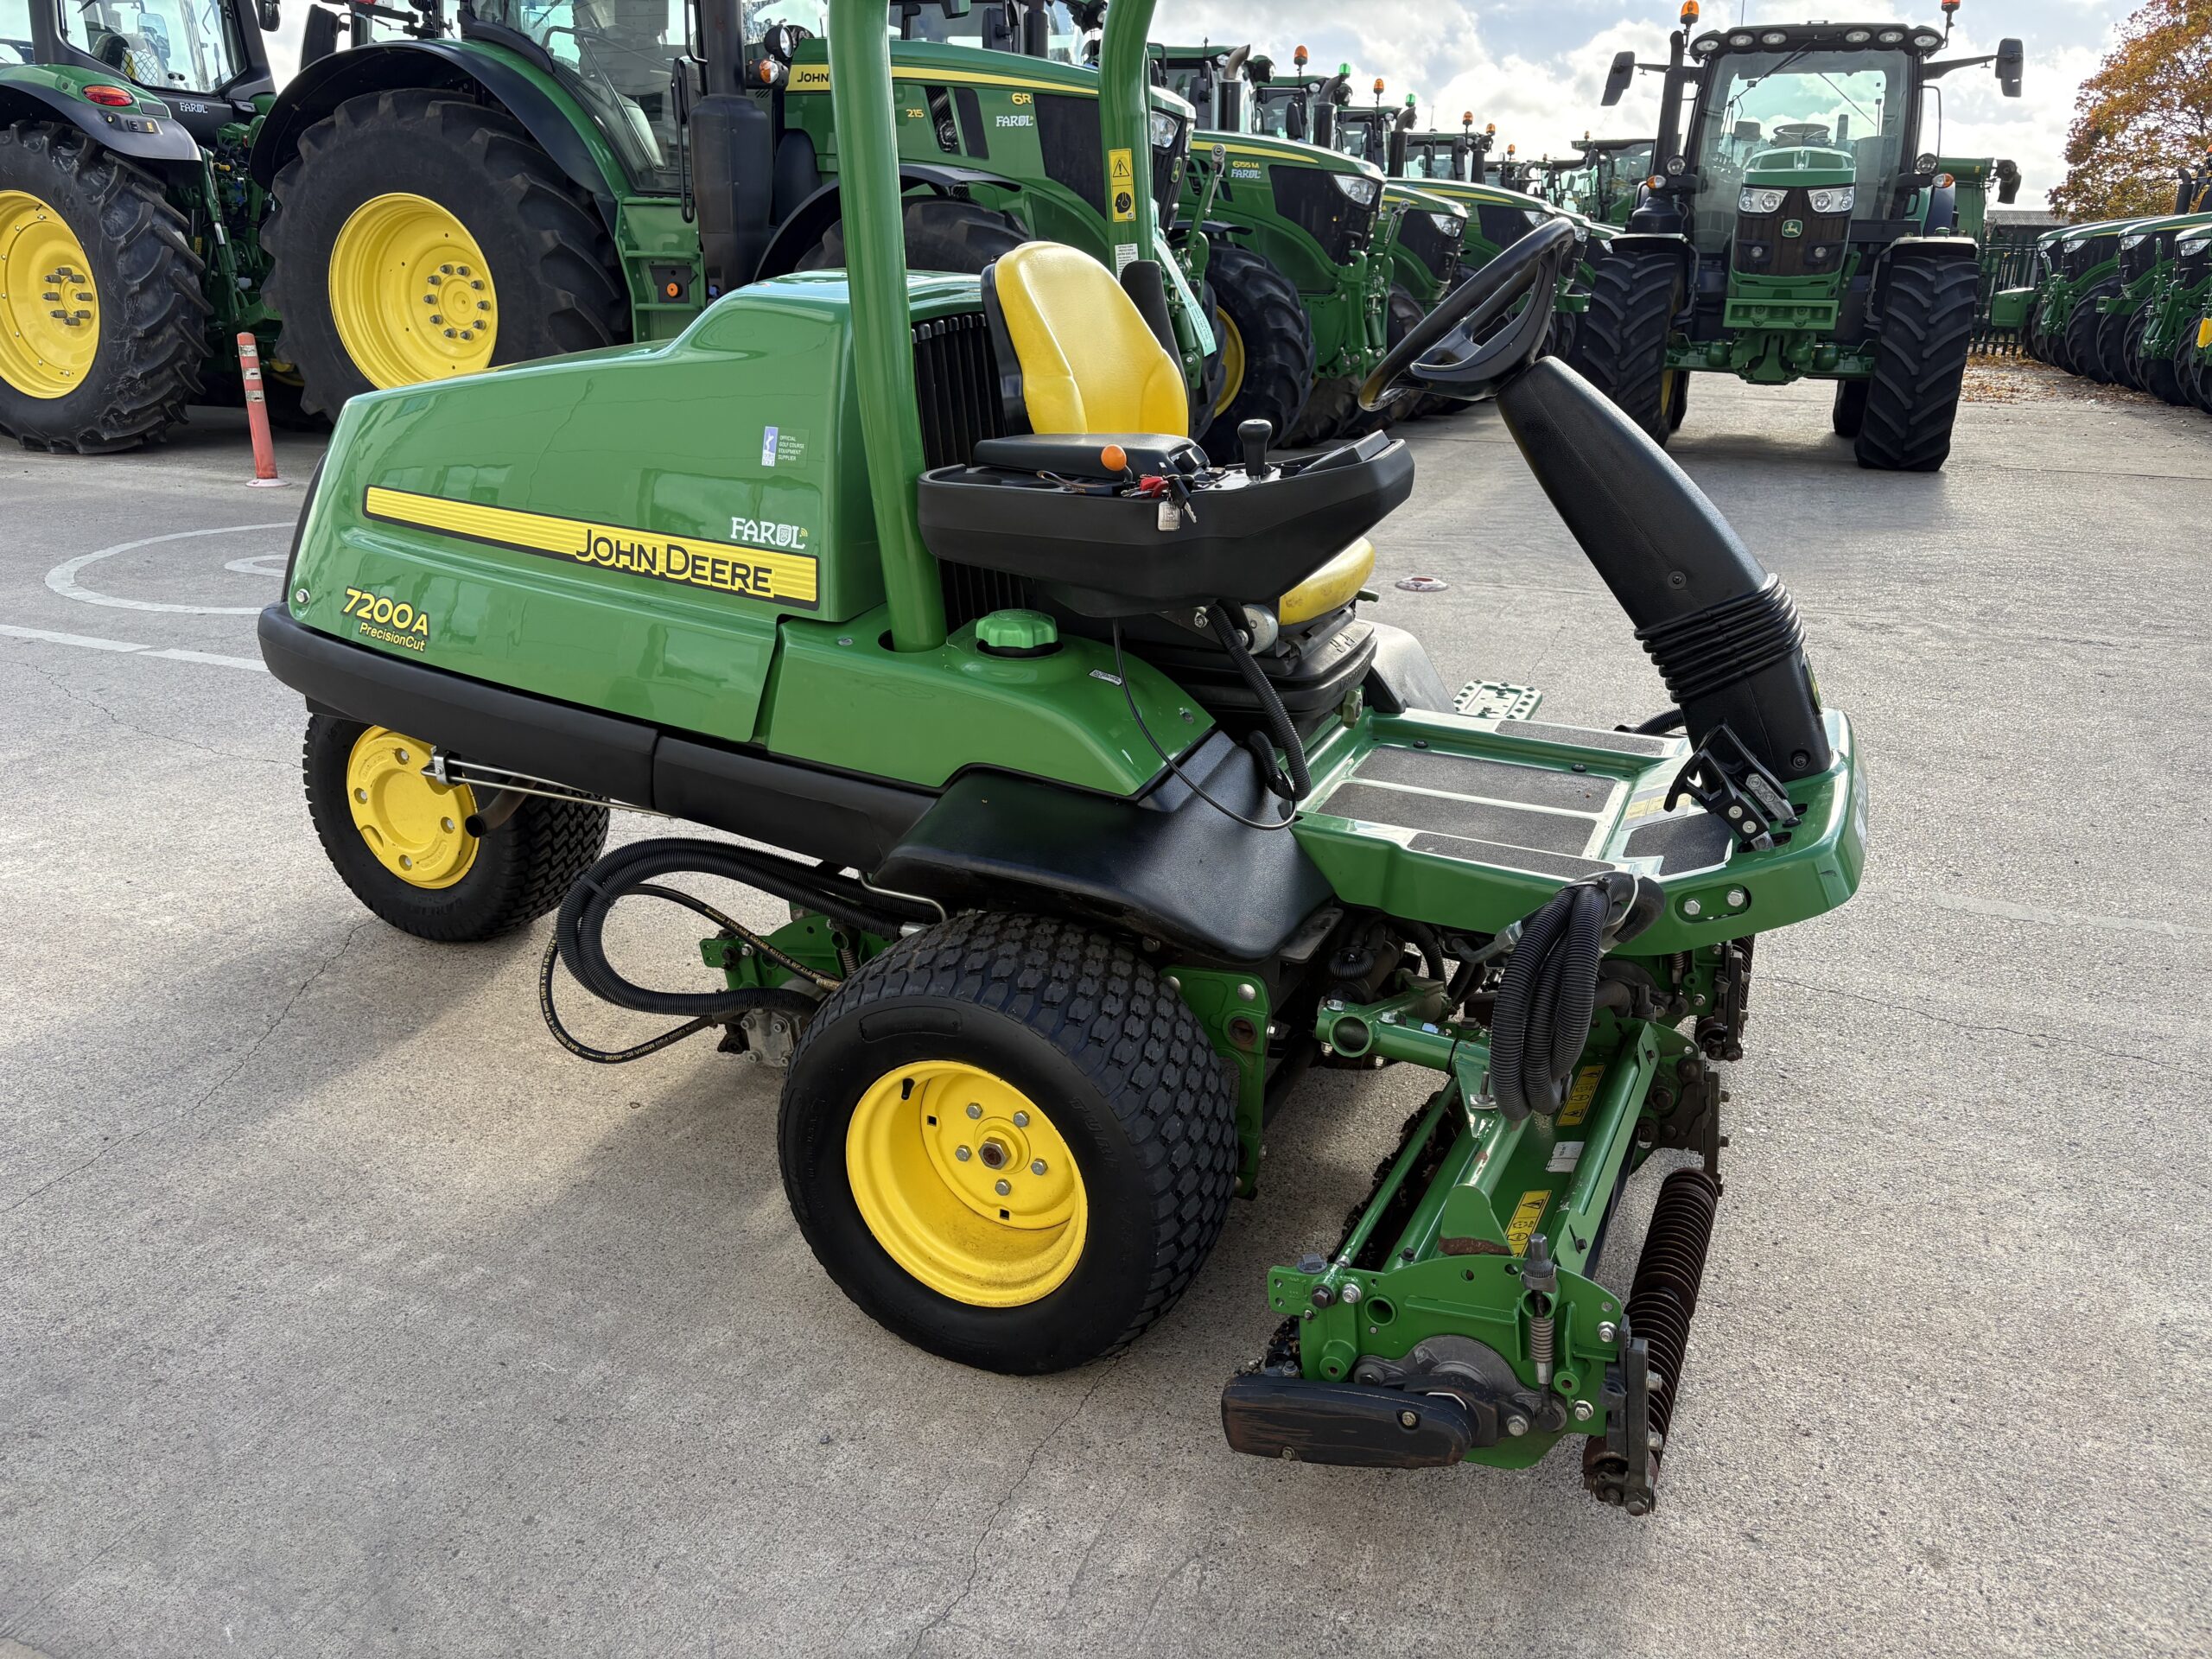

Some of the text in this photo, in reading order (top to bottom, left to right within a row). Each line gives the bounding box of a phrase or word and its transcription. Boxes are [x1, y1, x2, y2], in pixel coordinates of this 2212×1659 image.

[797, 71, 830, 83] JOHN
[1011, 92, 1033, 105] 6R
[180, 102, 208, 113] FAROL
[906, 109, 925, 118] 215
[995, 115, 1033, 127] FAROL
[1230, 168, 1261, 179] FAROL
[730, 517, 806, 550] FAROL
[575, 528, 773, 594] JOHN DEERE
[342, 587, 429, 637] 7200A
[359, 622, 426, 652] PrecisionCut
[750, 934, 770, 950] COVER
[635, 1042, 656, 1055] MSHA
